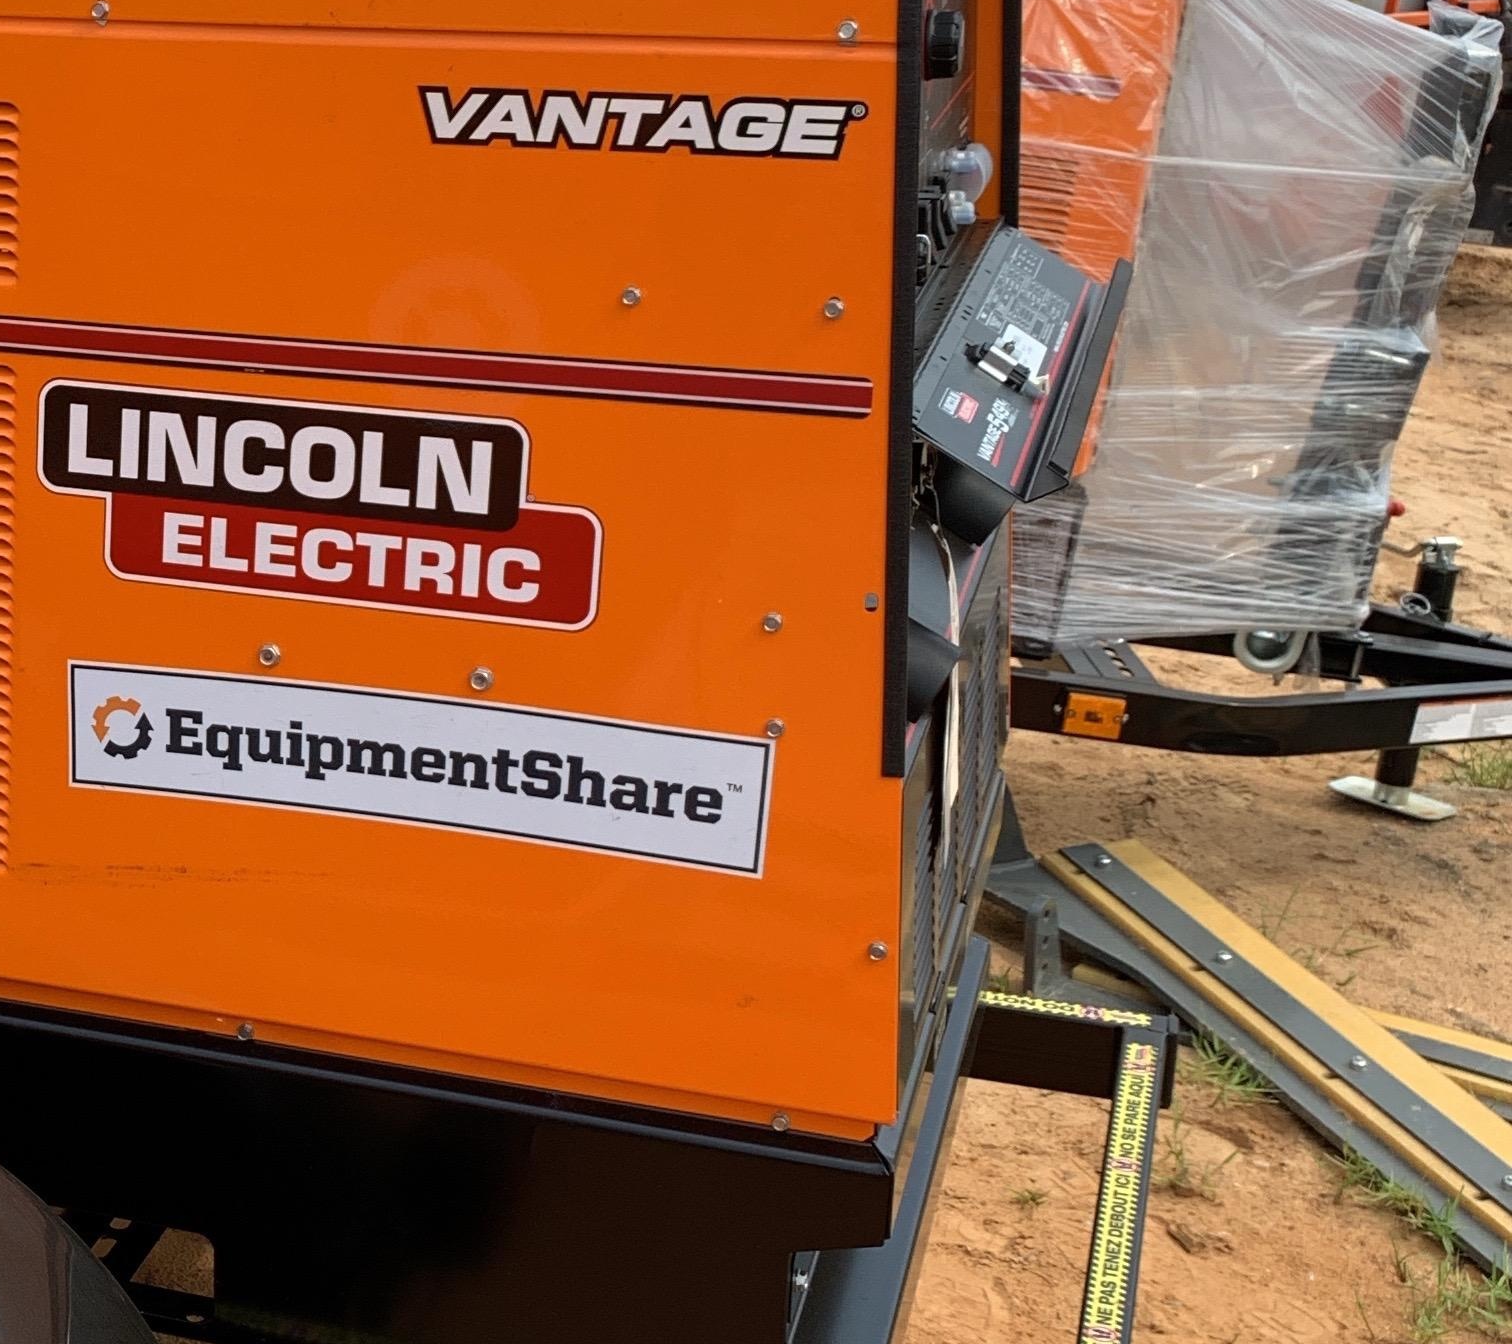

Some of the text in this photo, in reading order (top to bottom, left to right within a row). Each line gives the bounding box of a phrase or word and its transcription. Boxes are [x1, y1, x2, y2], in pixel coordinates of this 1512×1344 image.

[67, 401, 494, 516] LINCOLN
[161, 511, 541, 604] ELECTRIC
[1121, 1125, 1137, 1141] SE
[1124, 1100, 1141, 1126] PARE
[1118, 1142, 1136, 1158] NO
[1096, 1173, 1131, 1325] NE PAS TENEZ DEBOUT ICI
